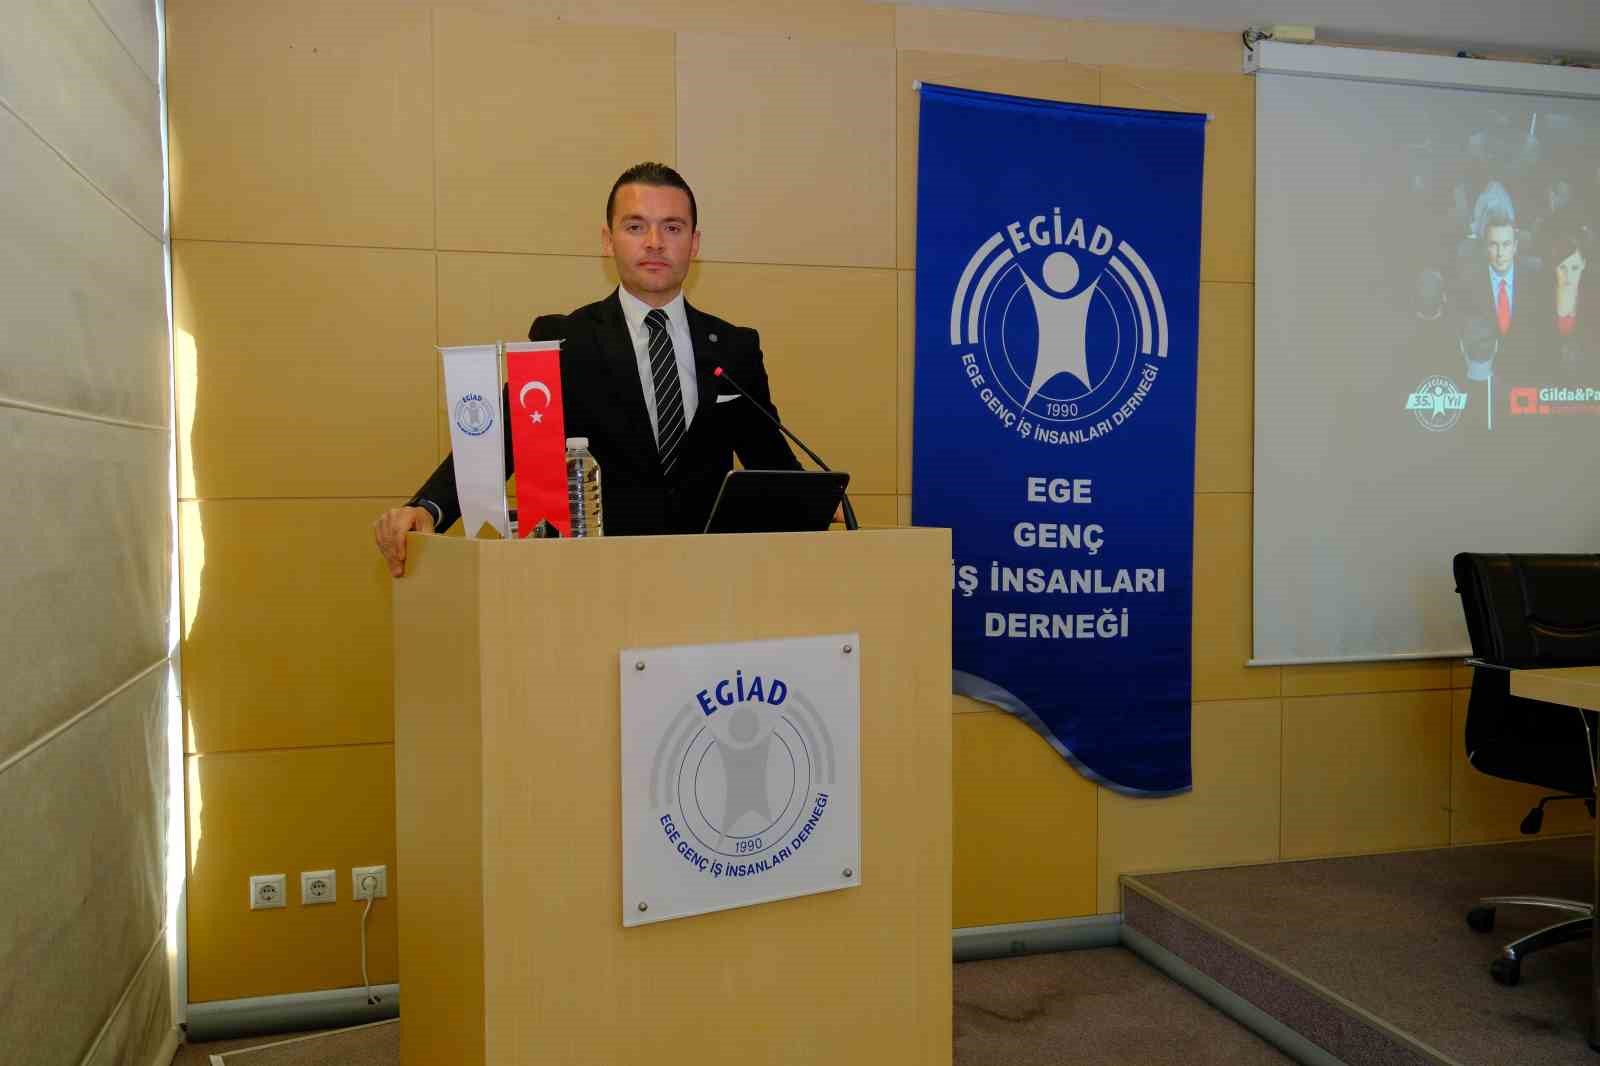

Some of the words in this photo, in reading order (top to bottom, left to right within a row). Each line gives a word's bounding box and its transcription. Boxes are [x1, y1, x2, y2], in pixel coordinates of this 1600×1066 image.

[1006, 206, 1114, 255] EGİAD
[961, 353, 983, 389] EGE
[980, 387, 1016, 427] GENÇ
[1016, 416, 1033, 439] İŞ
[1034, 418, 1113, 445] İNSANLARI
[1111, 363, 1159, 426] DERNEĞİ
[1046, 403, 1078, 418] 1990
[1027, 476, 1092, 504] EGE
[1013, 521, 1104, 555] GENÇ
[991, 560, 1165, 594] İNSANLARI
[984, 607, 1129, 639] DERNEĞİ
[696, 669, 788, 717] EGİAD
[660, 813, 681, 843] EGE
[676, 840, 710, 873] GENÇ
[709, 859, 723, 878] İŞ
[724, 846, 792, 878] İNSANLARI
[790, 791, 830, 850] DERNEĞİ
[735, 838, 763, 854] 1990
